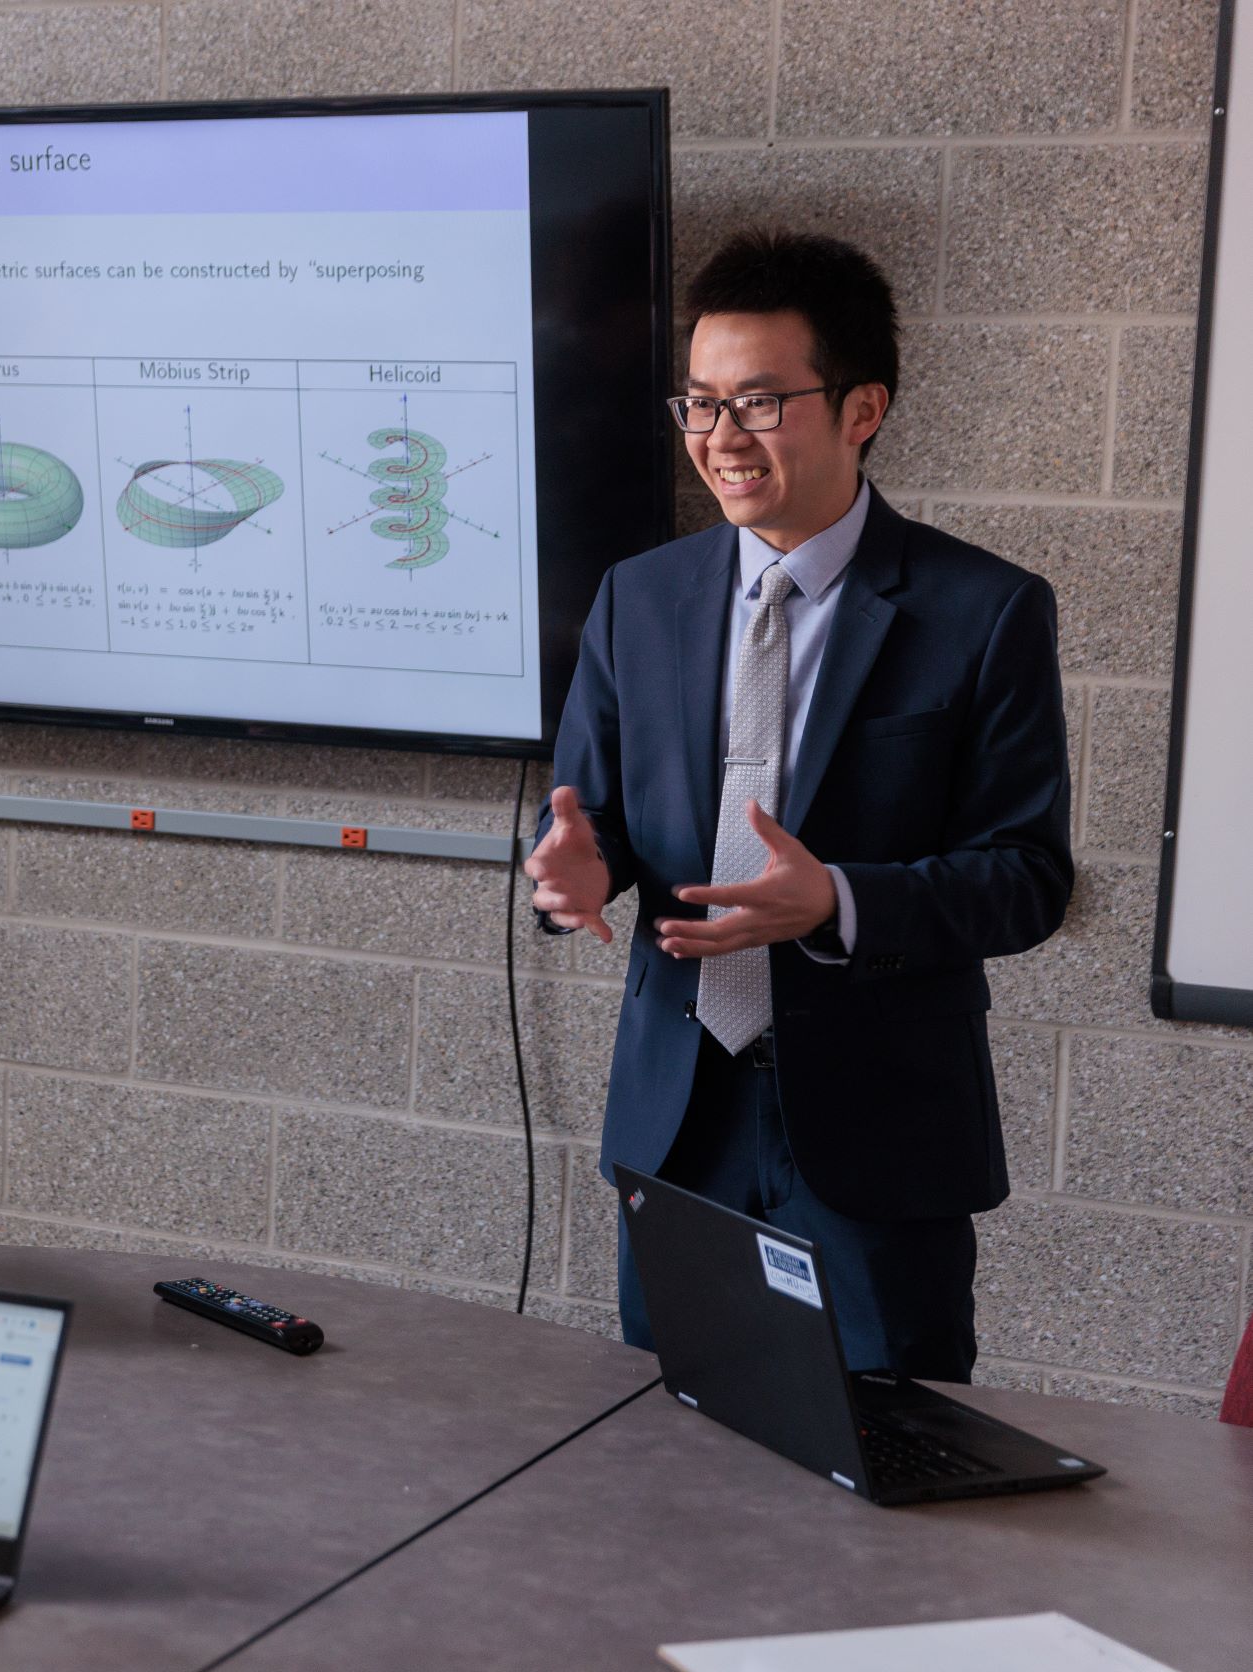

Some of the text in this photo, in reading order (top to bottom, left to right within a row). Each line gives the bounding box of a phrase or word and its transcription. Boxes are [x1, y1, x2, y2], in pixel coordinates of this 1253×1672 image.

[10, 145, 91, 171] surface
[35, 261, 100, 279] surfaces
[107, 264, 135, 279] can
[143, 262, 163, 278] be
[170, 260, 270, 279] constructed
[279, 260, 298, 283] by
[140, 361, 250, 384] Möbius Strip
[369, 364, 441, 382] Helicoid
